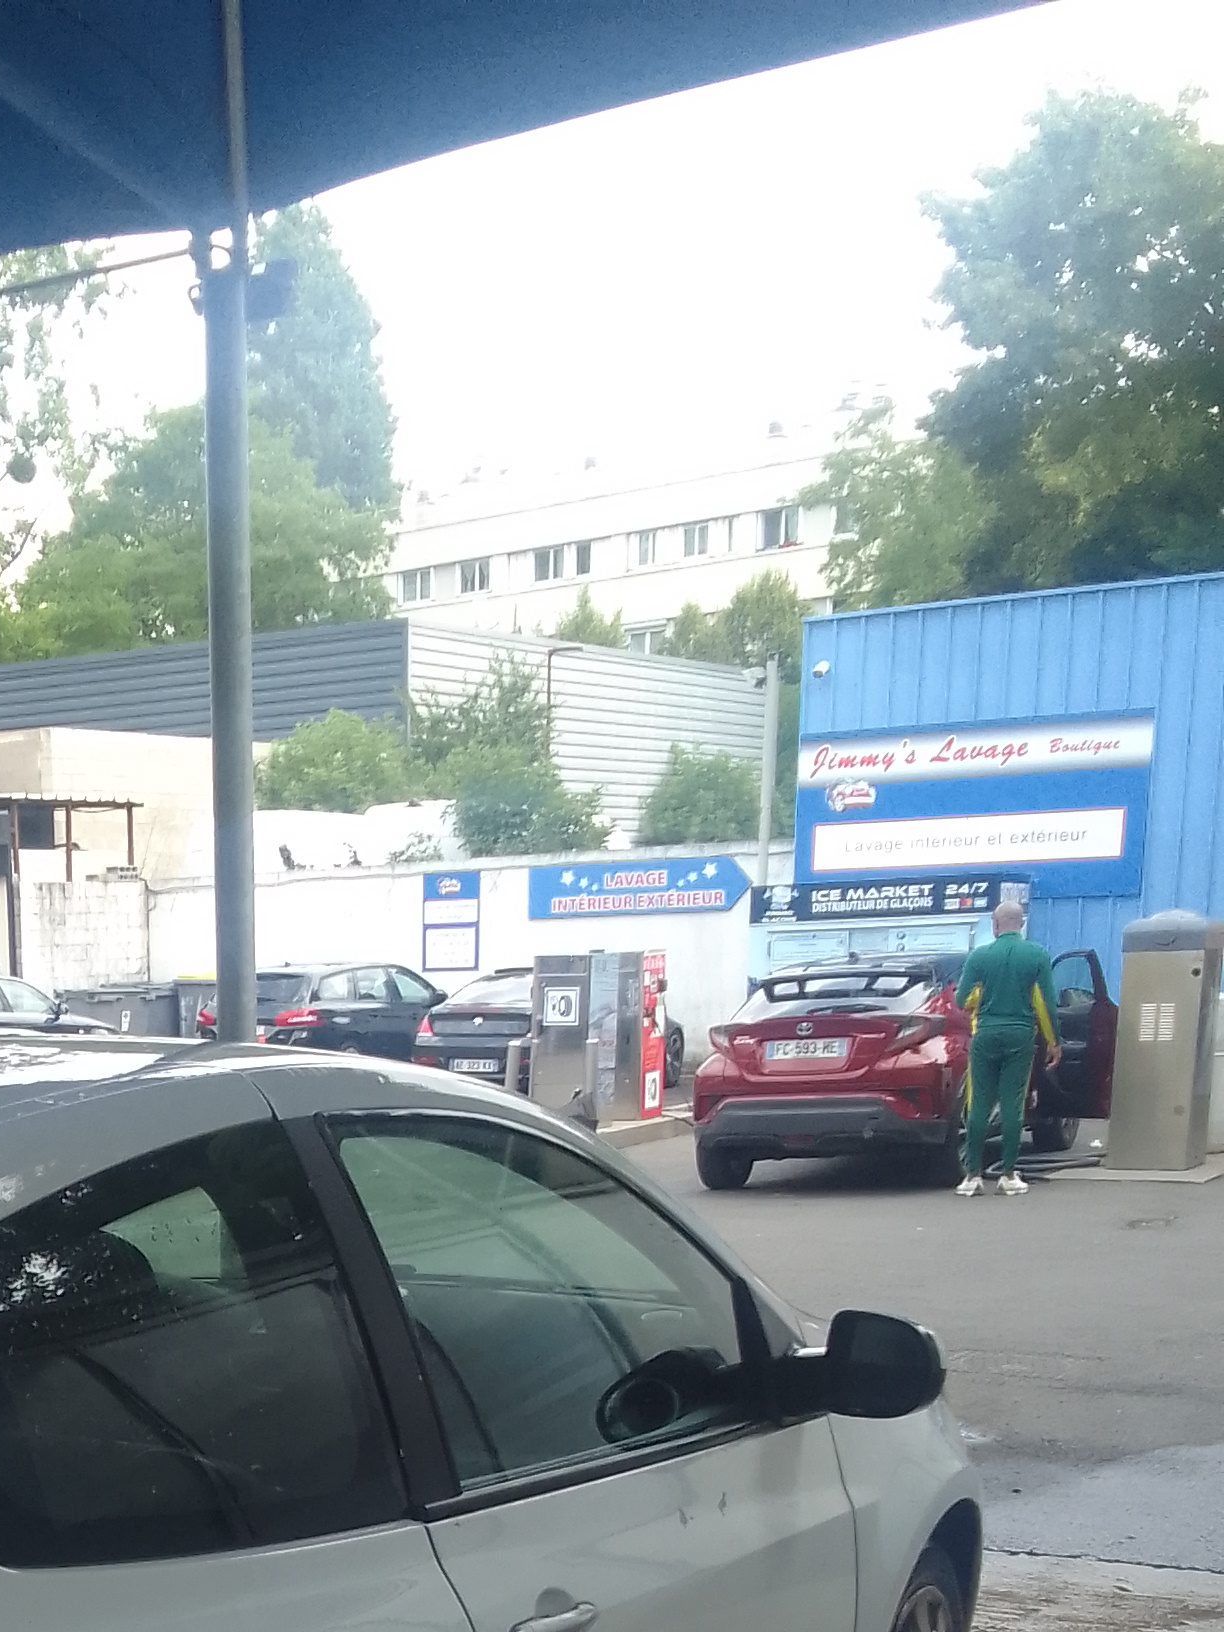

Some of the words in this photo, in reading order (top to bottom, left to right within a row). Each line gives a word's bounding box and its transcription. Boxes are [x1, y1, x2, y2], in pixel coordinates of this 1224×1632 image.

[810, 740, 917, 778] Jimmy's
[929, 735, 1029, 766] Lavage
[1049, 737, 1121, 756] Boutique
[844, 836, 904, 854] Lavage
[987, 830, 1003, 845] et
[1010, 827, 1087, 844] extérieur
[604, 870, 668, 888] LAVAGE
[551, 891, 633, 913] INTÉRIEUR
[637, 889, 724, 909] EXTÉRIEUR
[811, 888, 842, 902] ICE
[846, 884, 935, 900] MARKET
[944, 882, 989, 895] 24/7
[811, 899, 875, 914] DISTRIBUTEUR
[876, 898, 889, 910] DE
[890, 896, 934, 911] GLAÇONS
